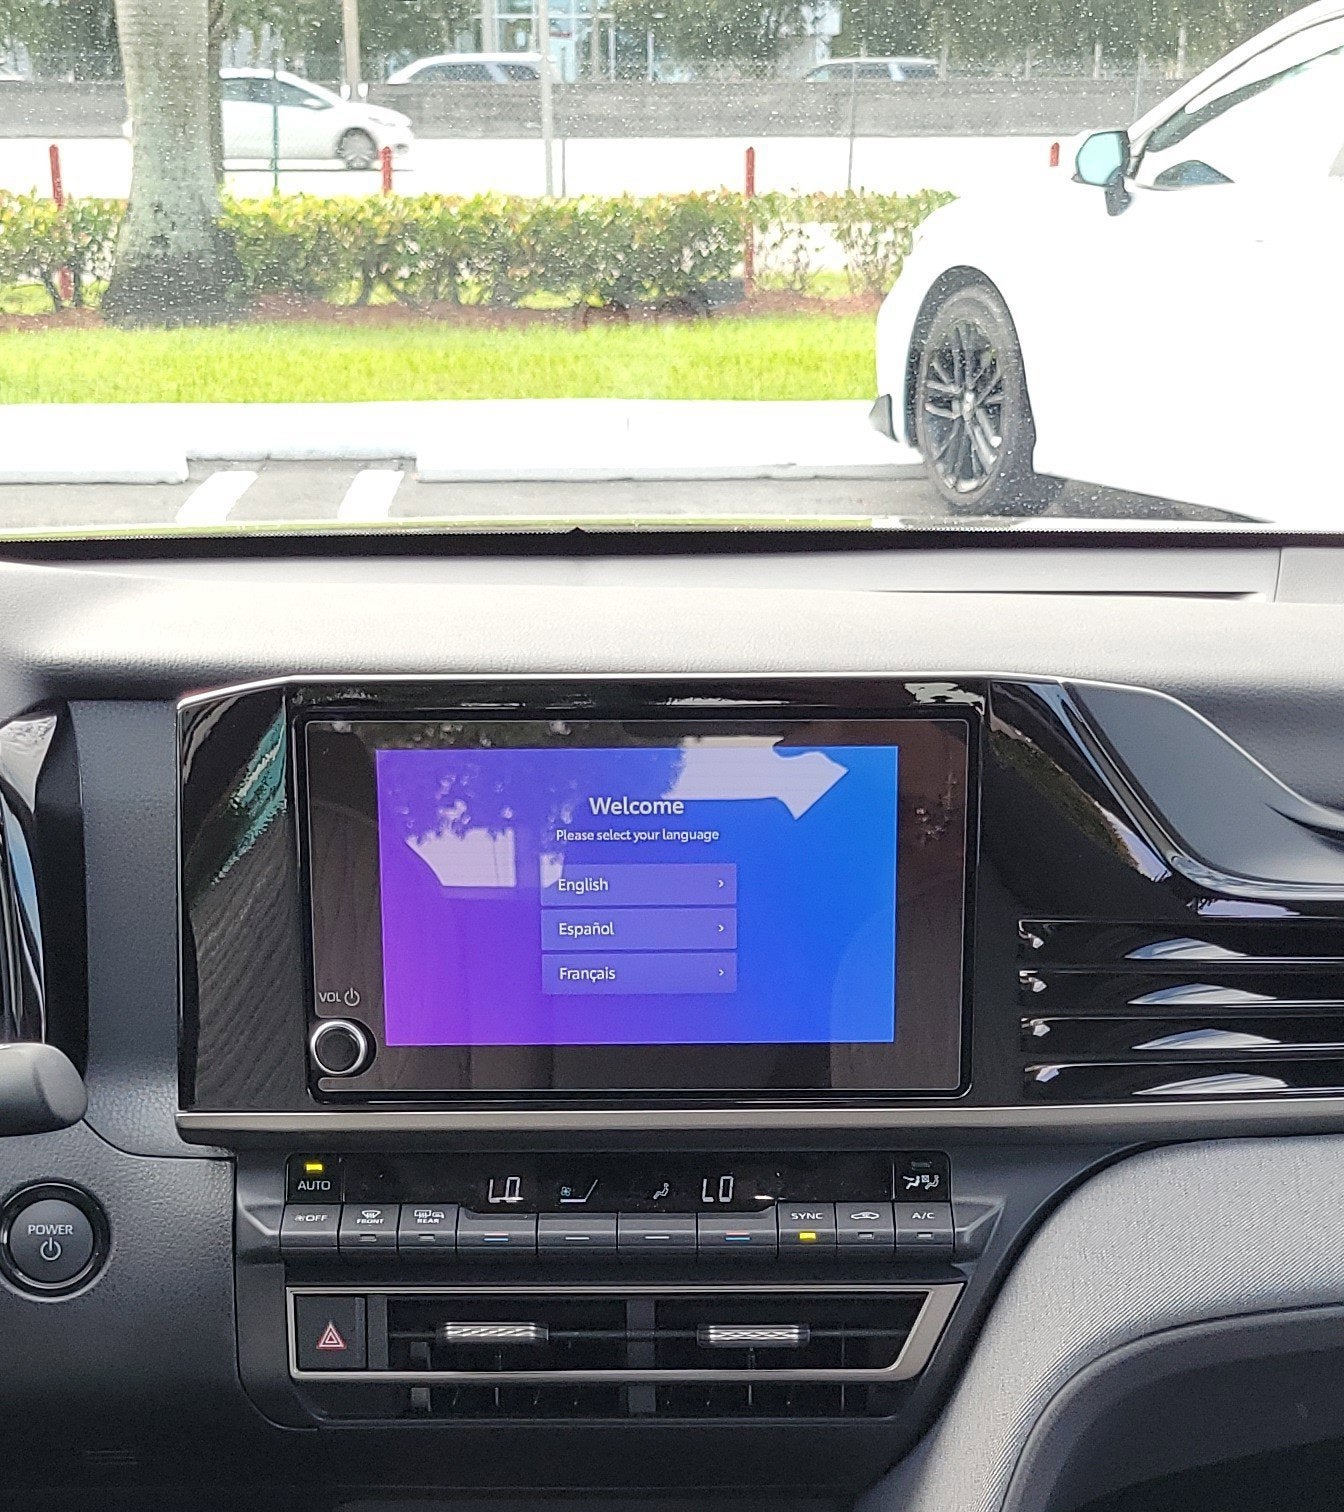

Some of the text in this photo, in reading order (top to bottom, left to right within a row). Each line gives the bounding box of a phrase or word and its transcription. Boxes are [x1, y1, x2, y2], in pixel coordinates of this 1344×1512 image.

[589, 796, 684, 815] Welcome
[556, 828, 720, 843] Please select your language
[558, 878, 609, 894] English
[559, 922, 614, 938] Español
[559, 966, 616, 982] Français
[319, 992, 342, 1002] VOL
[297, 1180, 331, 1191] AUTO
[701, 1176, 734, 1203] LO
[306, 1214, 328, 1222] OFF
[791, 1212, 823, 1220] SYNC
[912, 1212, 935, 1220] A/C
[28, 1224, 74, 1235] POWER
